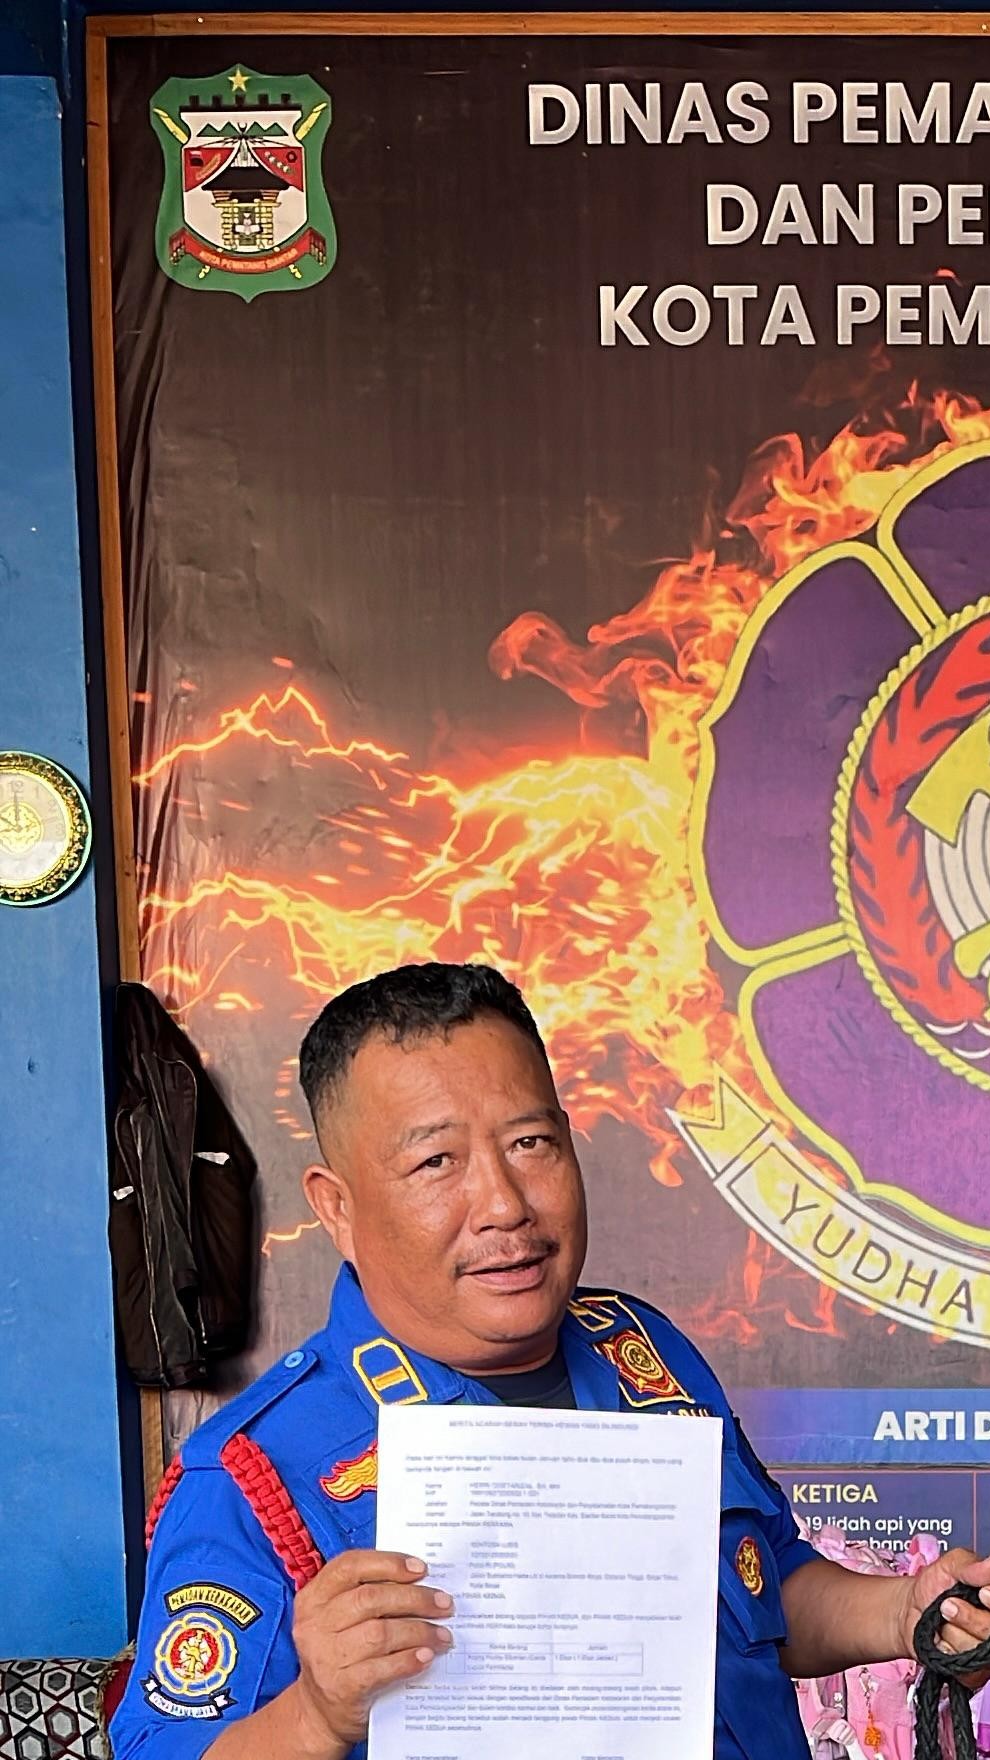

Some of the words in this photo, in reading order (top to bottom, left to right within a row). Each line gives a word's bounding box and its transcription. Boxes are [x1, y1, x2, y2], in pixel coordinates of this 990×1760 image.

[527, 81, 771, 144] DINAS
[706, 183, 874, 245] DAN
[599, 284, 816, 346] KOTA
[779, 1183, 976, 1323] YUDHA
[873, 1411, 965, 1441] ARTI
[792, 1484, 879, 1504] KETIGA
[875, 1516, 903, 1536] api
[907, 1518, 953, 1536] yang
